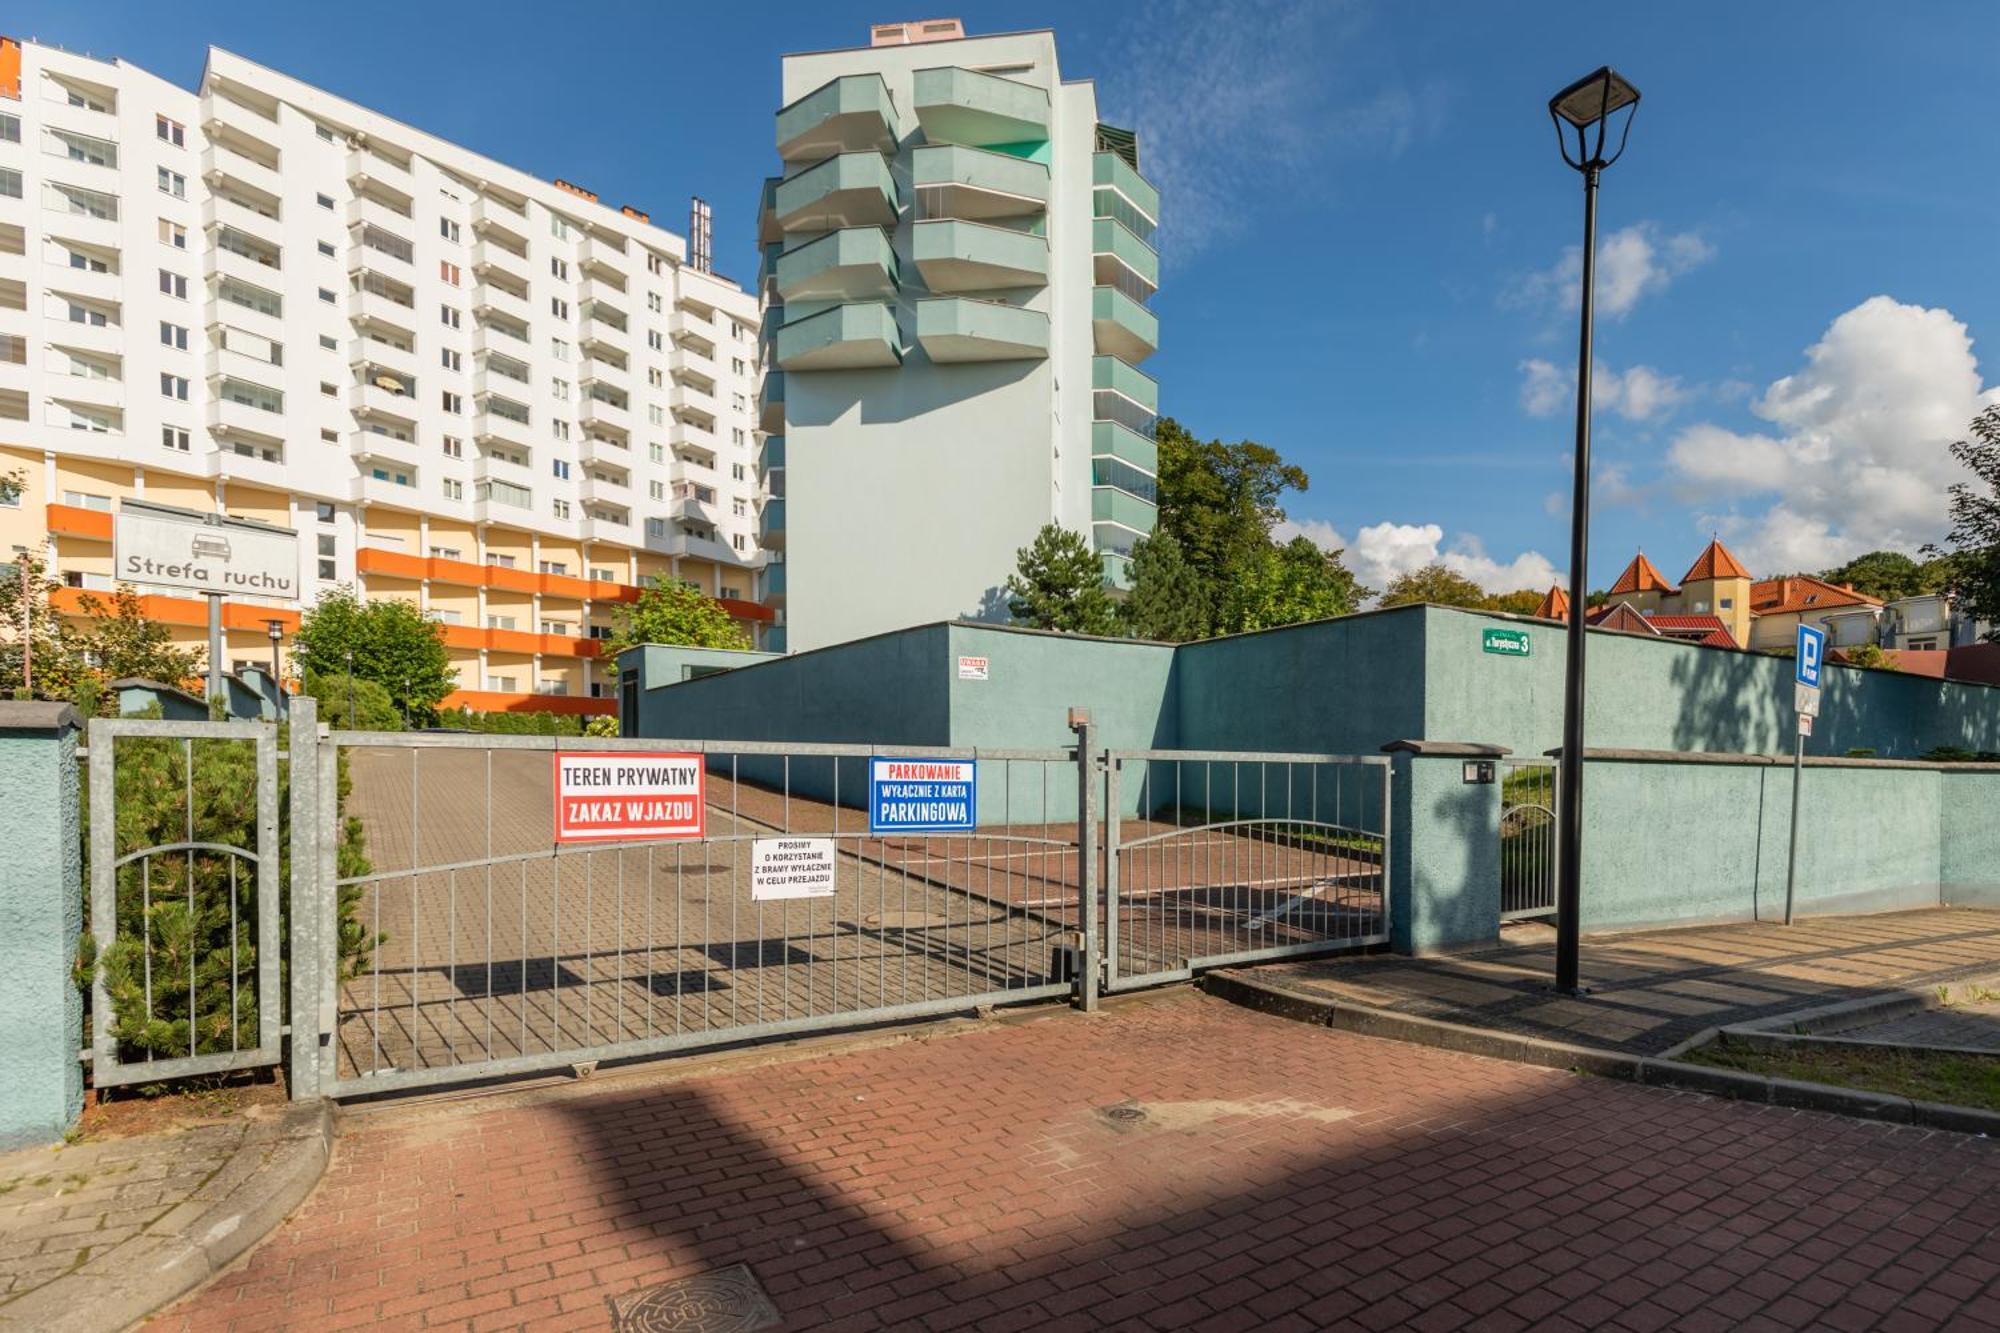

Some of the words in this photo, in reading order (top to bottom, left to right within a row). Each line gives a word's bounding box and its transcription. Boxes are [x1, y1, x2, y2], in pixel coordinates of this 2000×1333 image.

[127, 555, 209, 582] Strefa
[224, 571, 290, 591] ruchu
[1520, 635, 1529, 653] 3
[1803, 632, 1818, 677] P
[563, 767, 611, 786] TEREN
[617, 767, 697, 786] PRYWATNY
[888, 763, 961, 780] PARKOWANIE
[881, 784, 932, 799] WYŁĄCZNIE
[934, 785, 940, 798] Z
[568, 801, 622, 823] ZAKAZ
[626, 801, 693, 822] WJAZDU
[880, 802, 968, 824] PARKINGOWĄ
[778, 840, 812, 850] PROSIMY
[764, 853, 771, 861] O
[772, 851, 824, 861] KORZYSTANIE
[754, 866, 760, 874] Z
[761, 865, 789, 874] BRAMY
[756, 877, 764, 885] W
[766, 876, 786, 885] CELU
[787, 874, 830, 884] PRZEJAZDU
